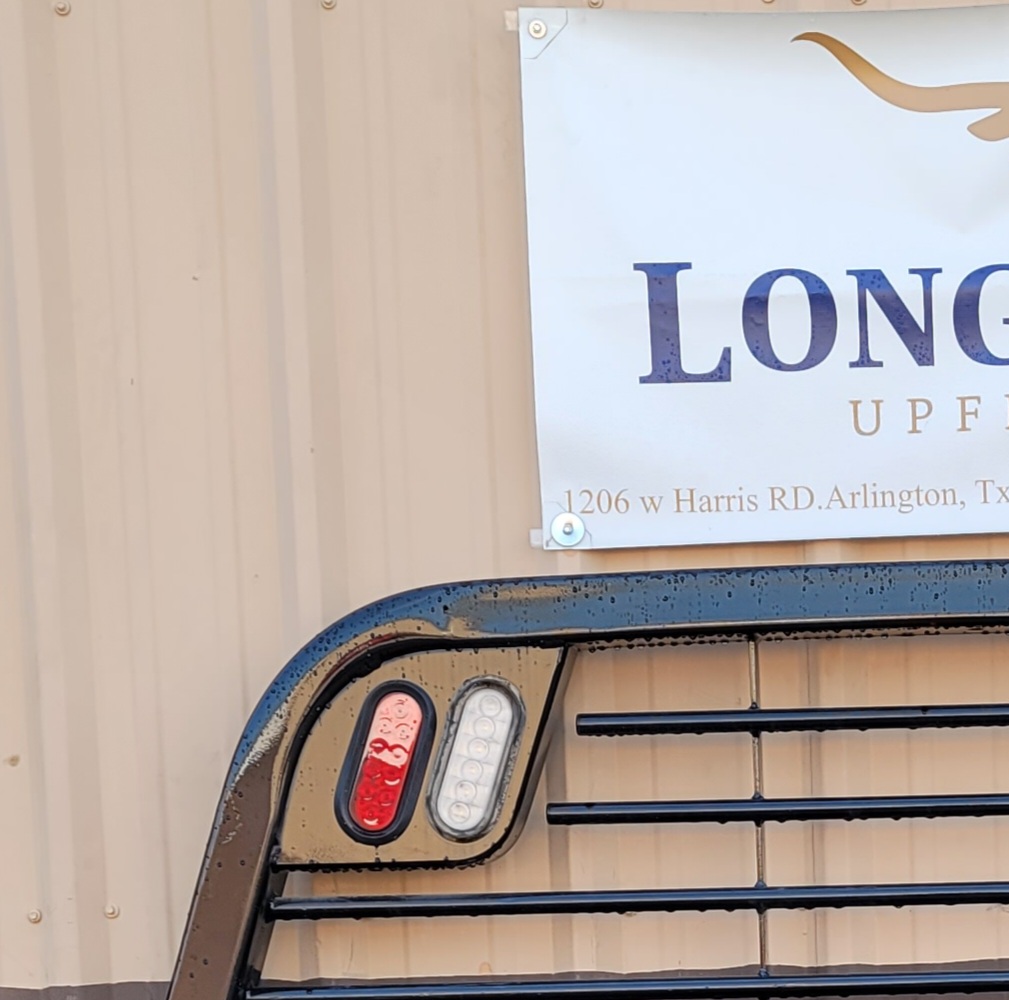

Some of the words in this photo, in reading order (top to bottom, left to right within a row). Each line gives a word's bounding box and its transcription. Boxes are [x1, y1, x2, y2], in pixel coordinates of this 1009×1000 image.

[564, 488, 630, 514] 1206
[640, 494, 664, 514] w
[674, 486, 759, 513] Harris
